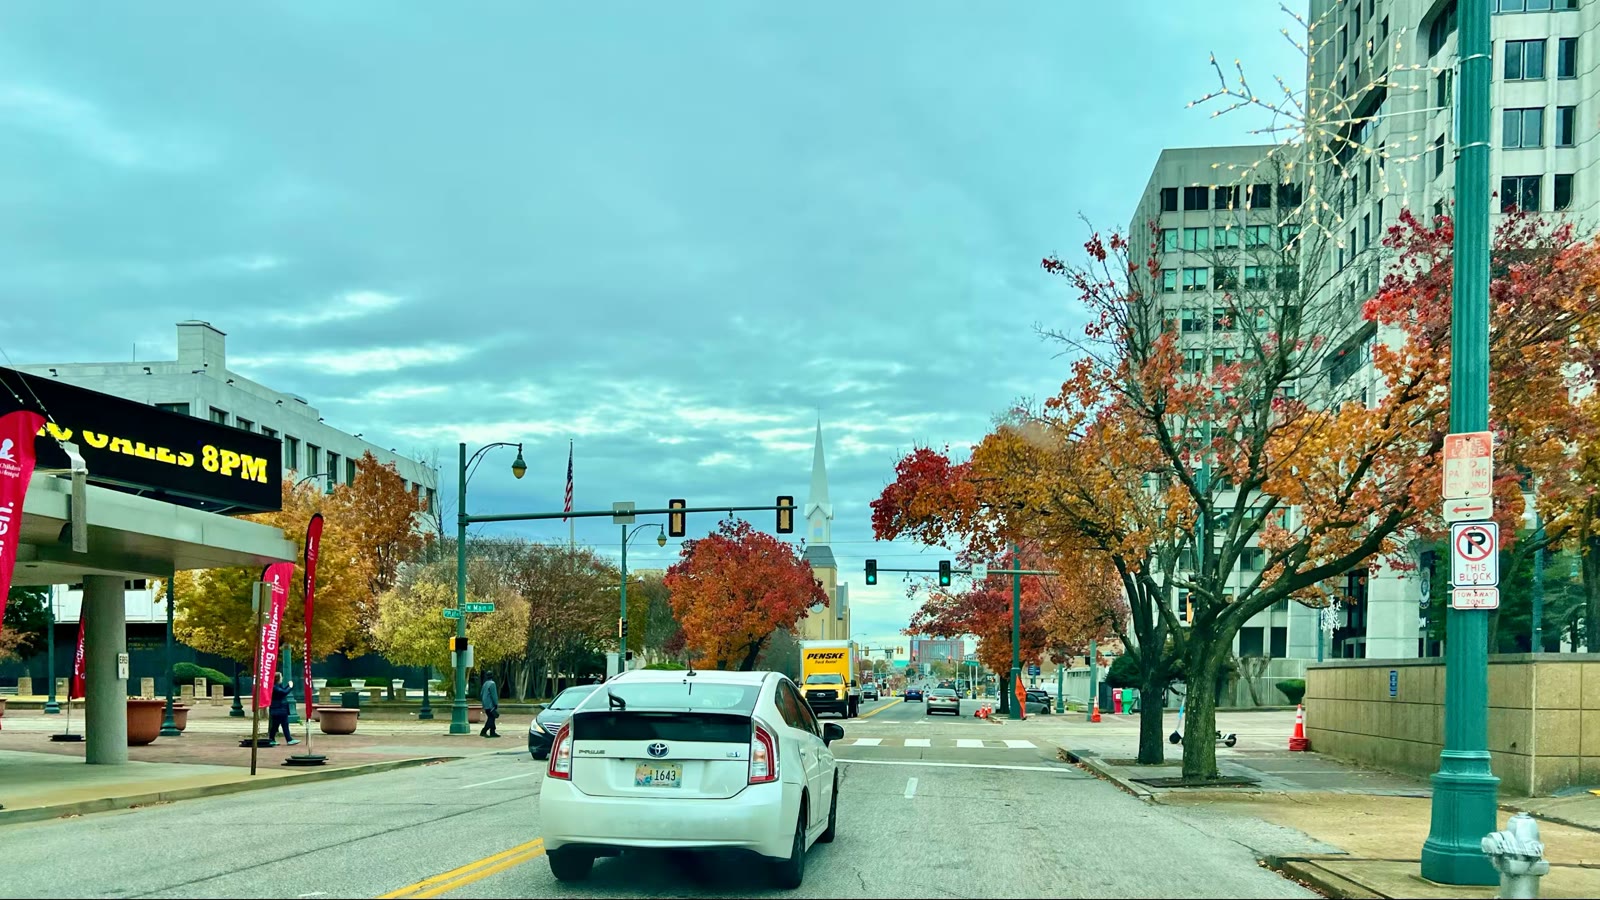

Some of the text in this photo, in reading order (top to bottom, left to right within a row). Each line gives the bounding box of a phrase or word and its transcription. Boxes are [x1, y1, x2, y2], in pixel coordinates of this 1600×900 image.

[202, 444, 268, 484] 8PM
[1465, 563, 1487, 572] THIS
[1459, 572, 1492, 581] BLOCK
[806, 652, 846, 660] PENSKE
[654, 769, 677, 781] 1643
